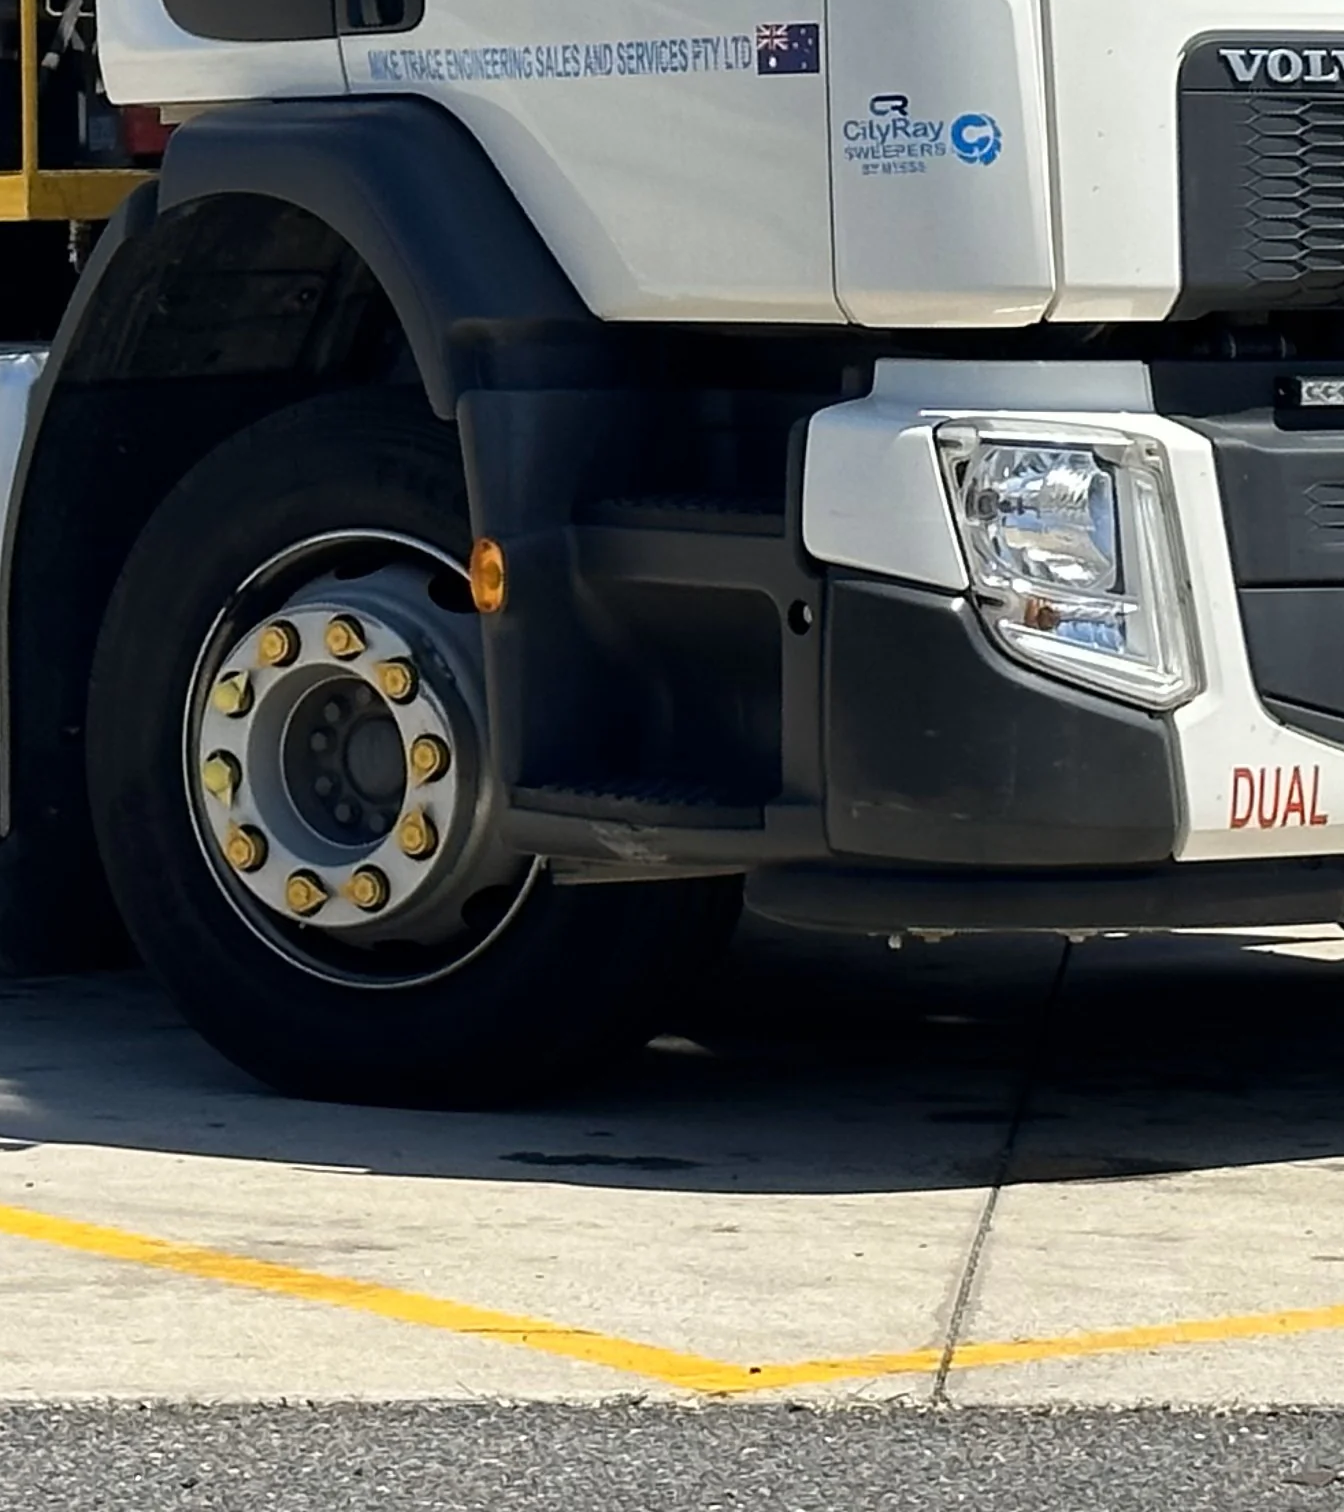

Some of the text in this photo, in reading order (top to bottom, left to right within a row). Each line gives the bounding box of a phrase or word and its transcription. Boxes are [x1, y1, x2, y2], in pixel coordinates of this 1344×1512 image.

[401, 49, 445, 81] TRACE
[445, 46, 534, 80] ENGINEERING
[535, 44, 580, 78] SALES
[584, 43, 613, 76] AND
[616, 39, 688, 76] SERVICES
[691, 36, 721, 72] PTY
[723, 35, 752, 70] LTD
[843, 118, 944, 144] CityRay
[844, 142, 946, 161] SWEEPERS
[1229, 766, 1328, 829] DUAL
